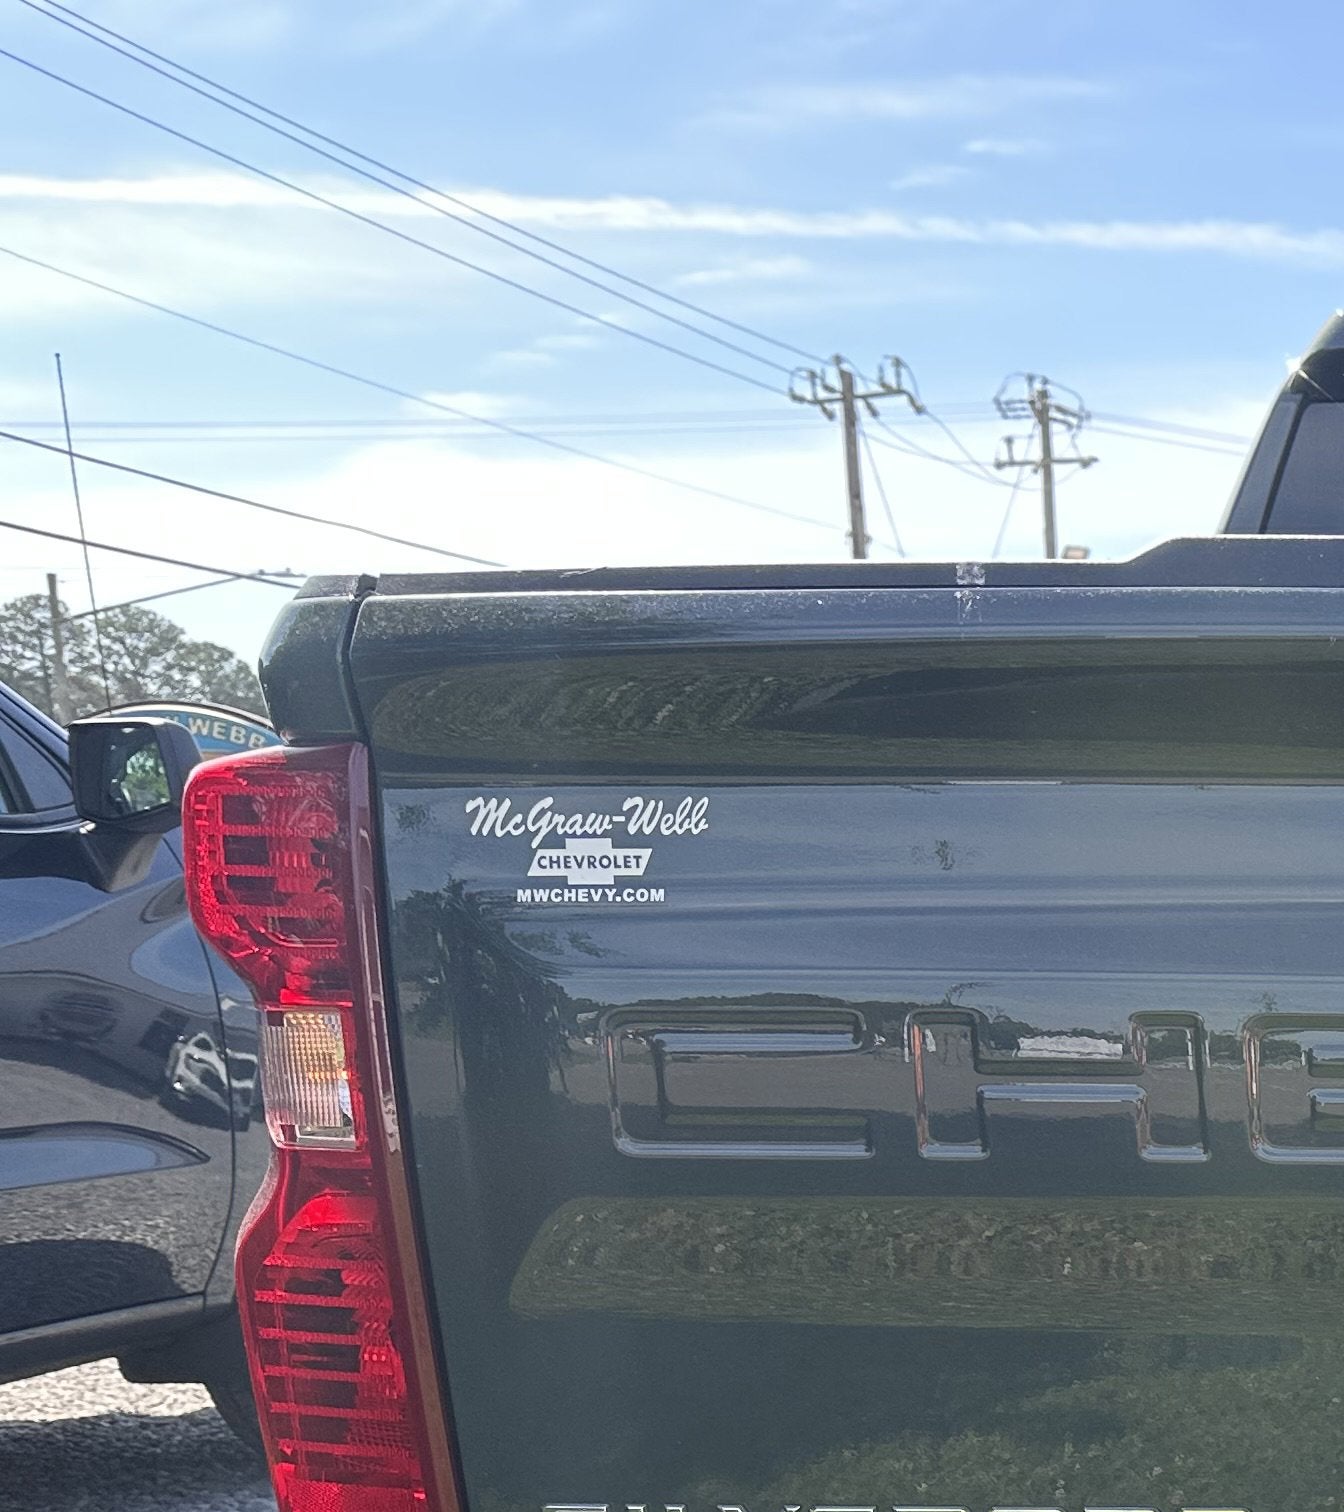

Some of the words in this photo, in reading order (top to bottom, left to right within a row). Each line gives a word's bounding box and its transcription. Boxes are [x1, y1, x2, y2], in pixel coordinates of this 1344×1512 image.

[188, 717, 267, 749] WEBB
[465, 796, 709, 849] McGraw-Webb
[537, 854, 643, 870] CHEVROLET
[516, 888, 665, 903] MWCHEVY.COM
